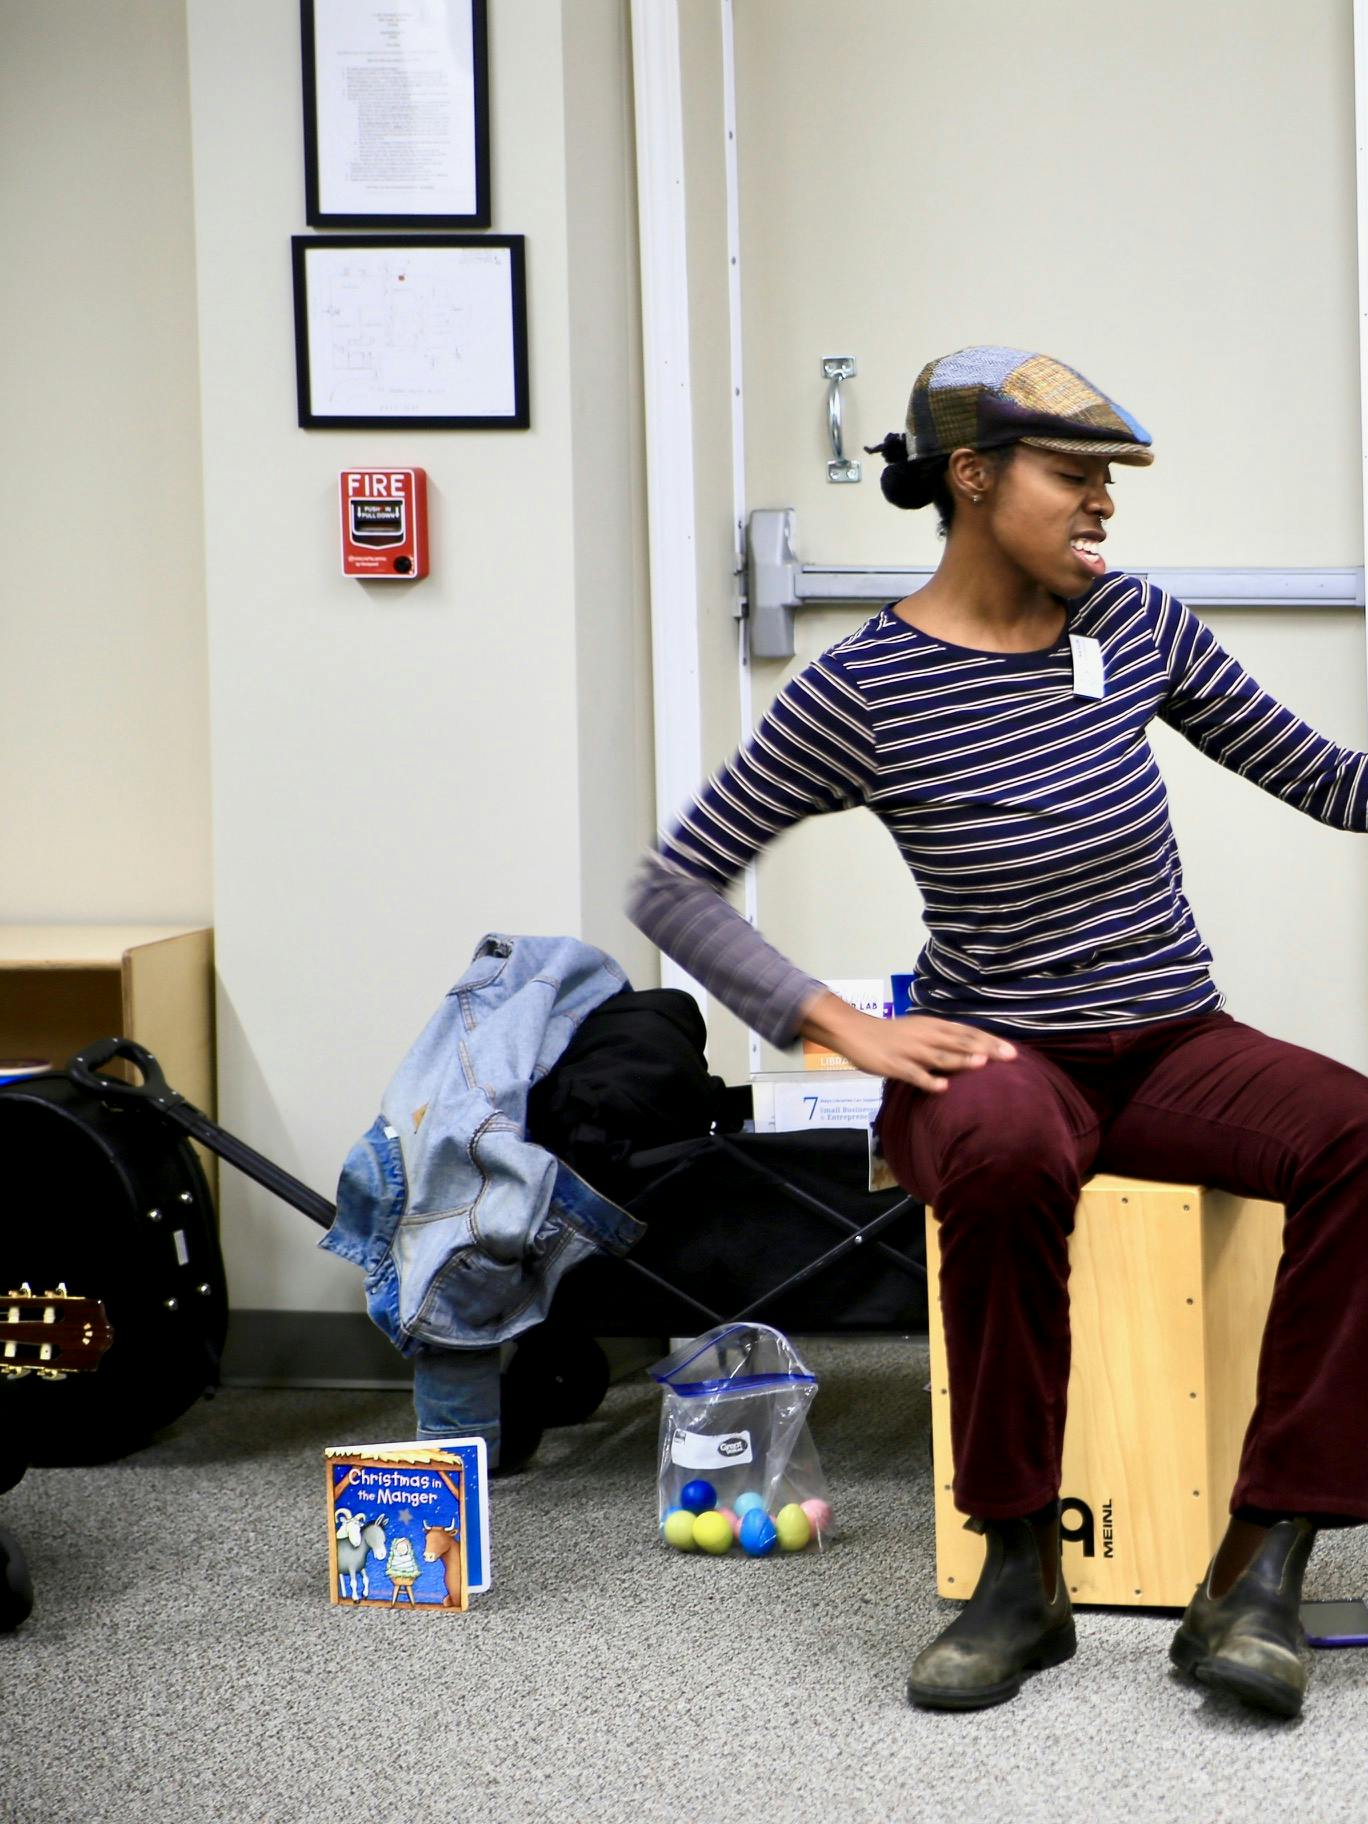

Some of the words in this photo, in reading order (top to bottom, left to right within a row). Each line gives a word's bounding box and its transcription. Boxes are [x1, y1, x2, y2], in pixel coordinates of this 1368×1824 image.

[348, 474, 405, 496] FIRE
[803, 1096, 819, 1121] 7
[348, 1469, 429, 1488] Christmas
[432, 1478, 442, 1488] in
[358, 1490, 375, 1501] the
[377, 1489, 438, 1506] Manger
[1103, 1499, 1113, 1558] MEINL
